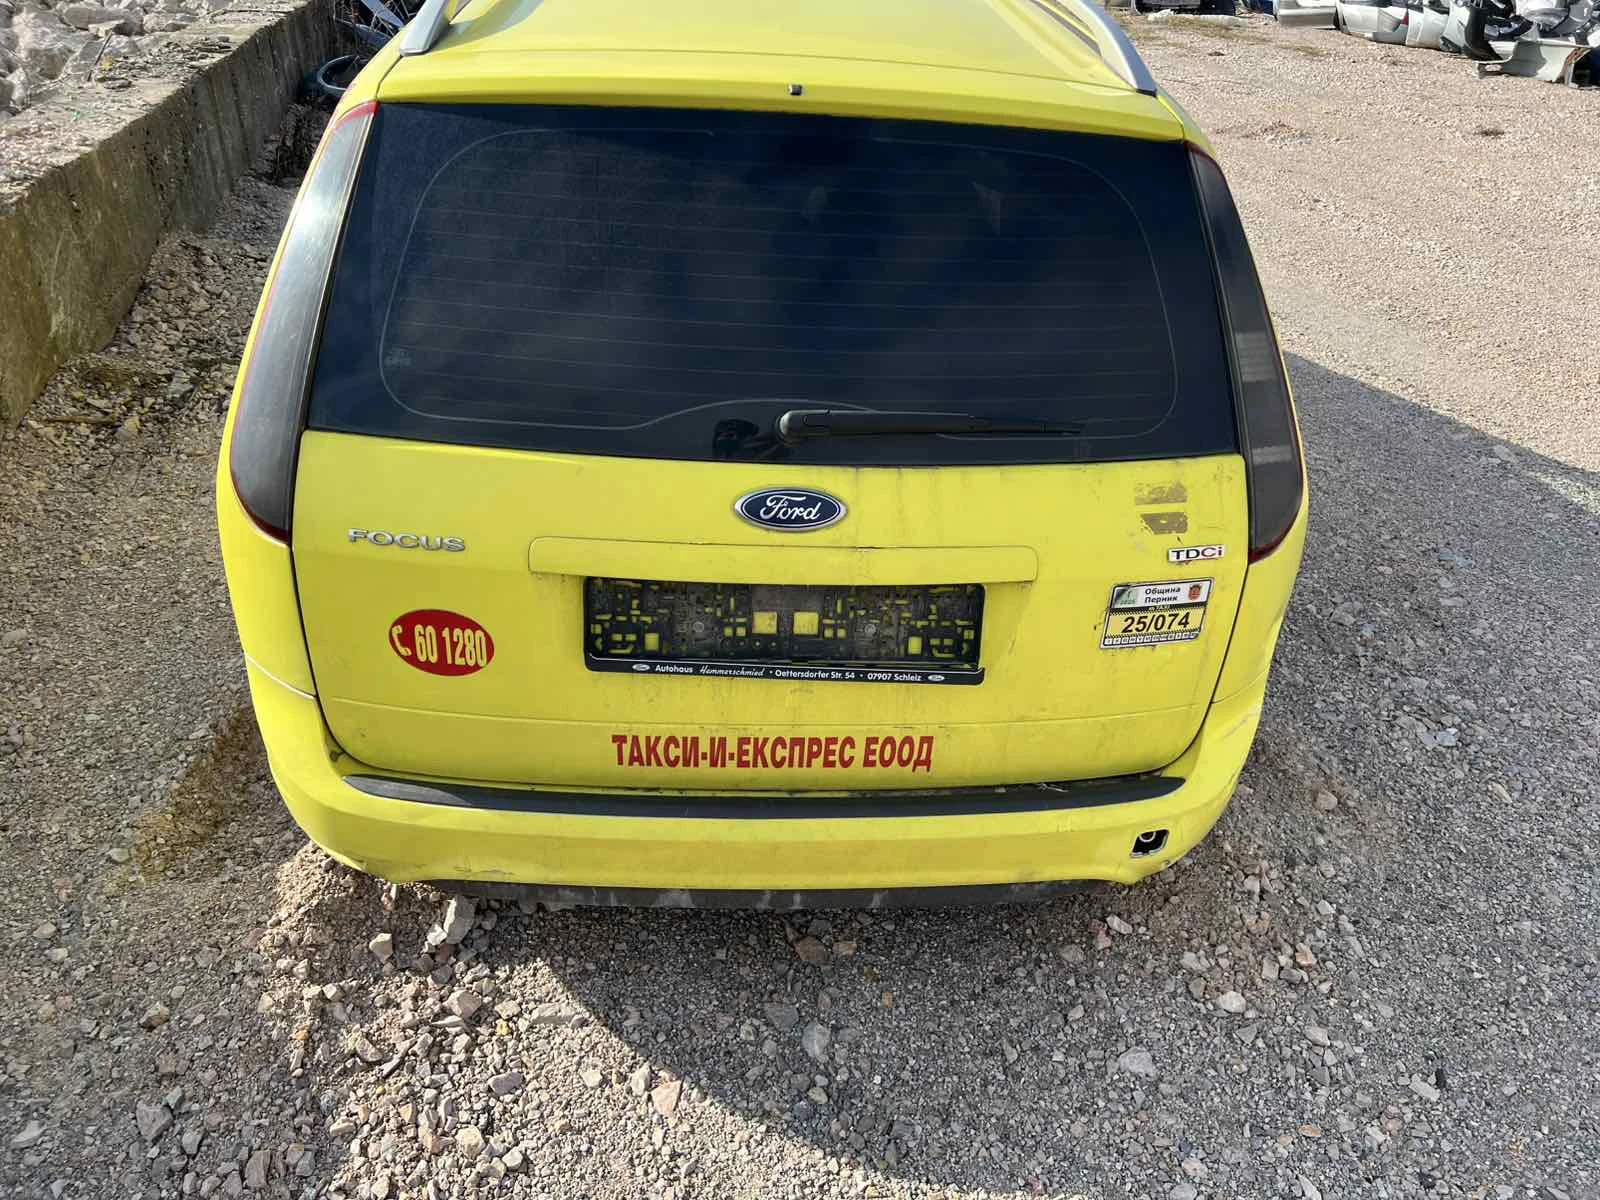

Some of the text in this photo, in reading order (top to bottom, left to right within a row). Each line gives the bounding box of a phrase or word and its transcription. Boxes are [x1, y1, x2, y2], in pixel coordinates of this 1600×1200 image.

[760, 494, 822, 520] Ford
[347, 528, 466, 552] FOCUS
[1171, 546, 1223, 561] TDCi
[1144, 586, 1181, 596] Община
[1144, 596, 1178, 604] Перник
[1121, 612, 1190, 633] 25/074
[414, 624, 488, 667] 60 1280
[655, 664, 693, 674] Autohaus
[775, 669, 829, 679] Oettersdorfer
[831, 671, 843, 679] Str.
[867, 673, 892, 681] 07907
[893, 673, 922, 682] Schleiz
[611, 735, 934, 773] ТАКСИ-И-ЕКСПРЕС ЕООД
